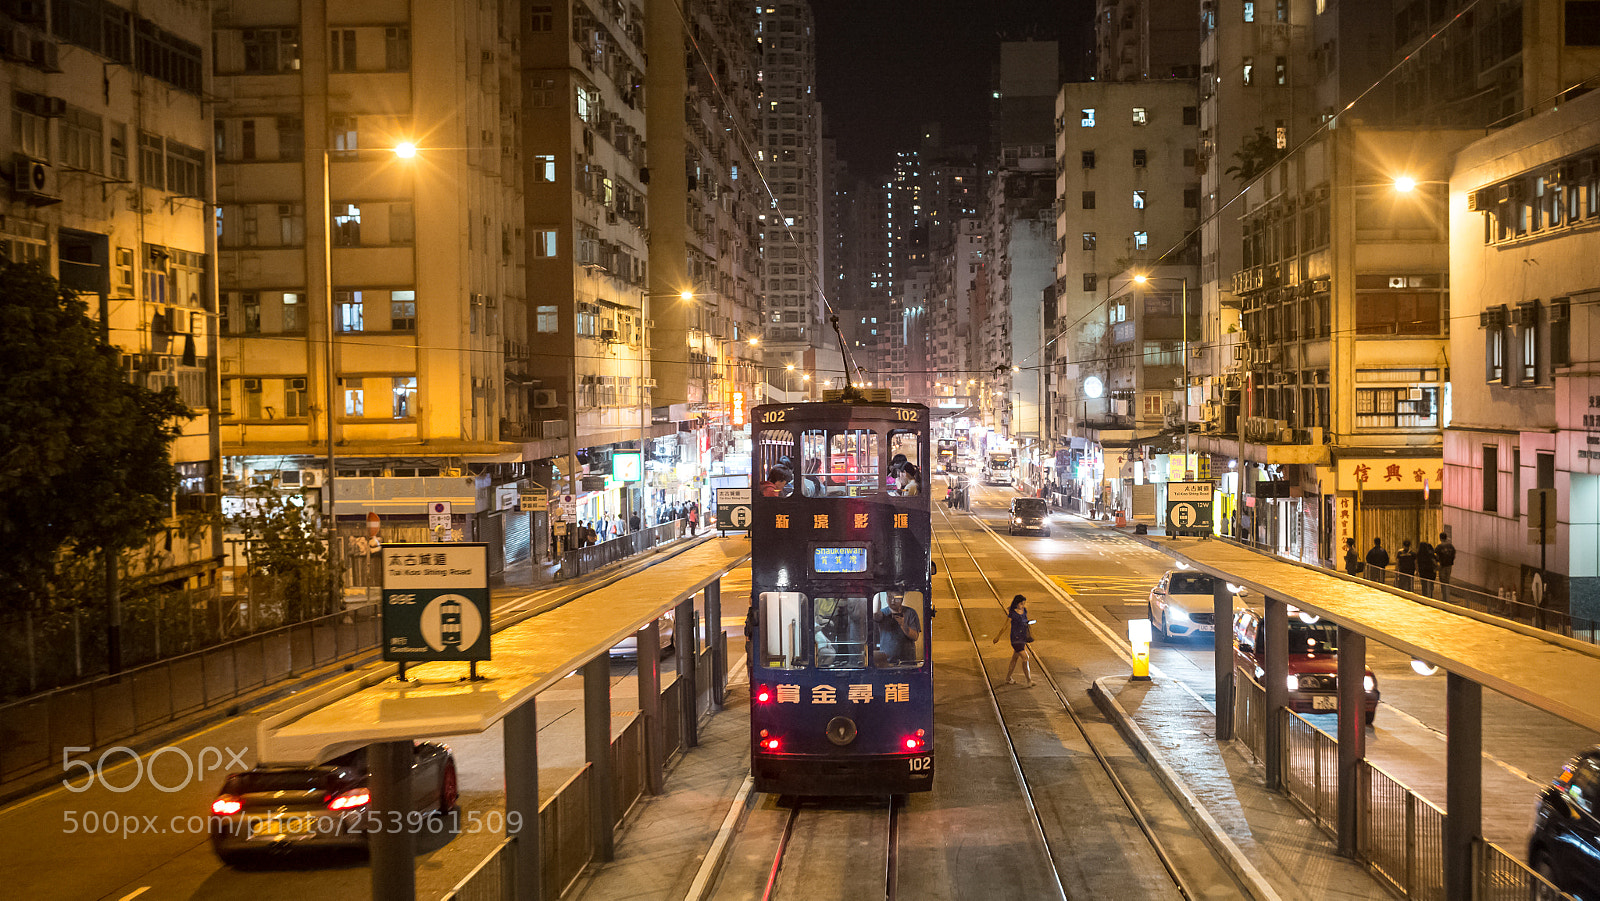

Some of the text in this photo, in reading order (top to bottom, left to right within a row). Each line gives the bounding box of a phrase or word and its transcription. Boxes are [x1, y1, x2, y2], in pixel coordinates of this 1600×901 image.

[764, 410, 785, 423] 102
[896, 409, 918, 422] 102
[815, 547, 863, 555] Shaukeiwan
[389, 553, 447, 566] 太古城道
[389, 568, 473, 577] Tai Koo Shing Road
[776, 683, 911, 704] 賞金尋龍
[908, 756, 931, 771] 102
